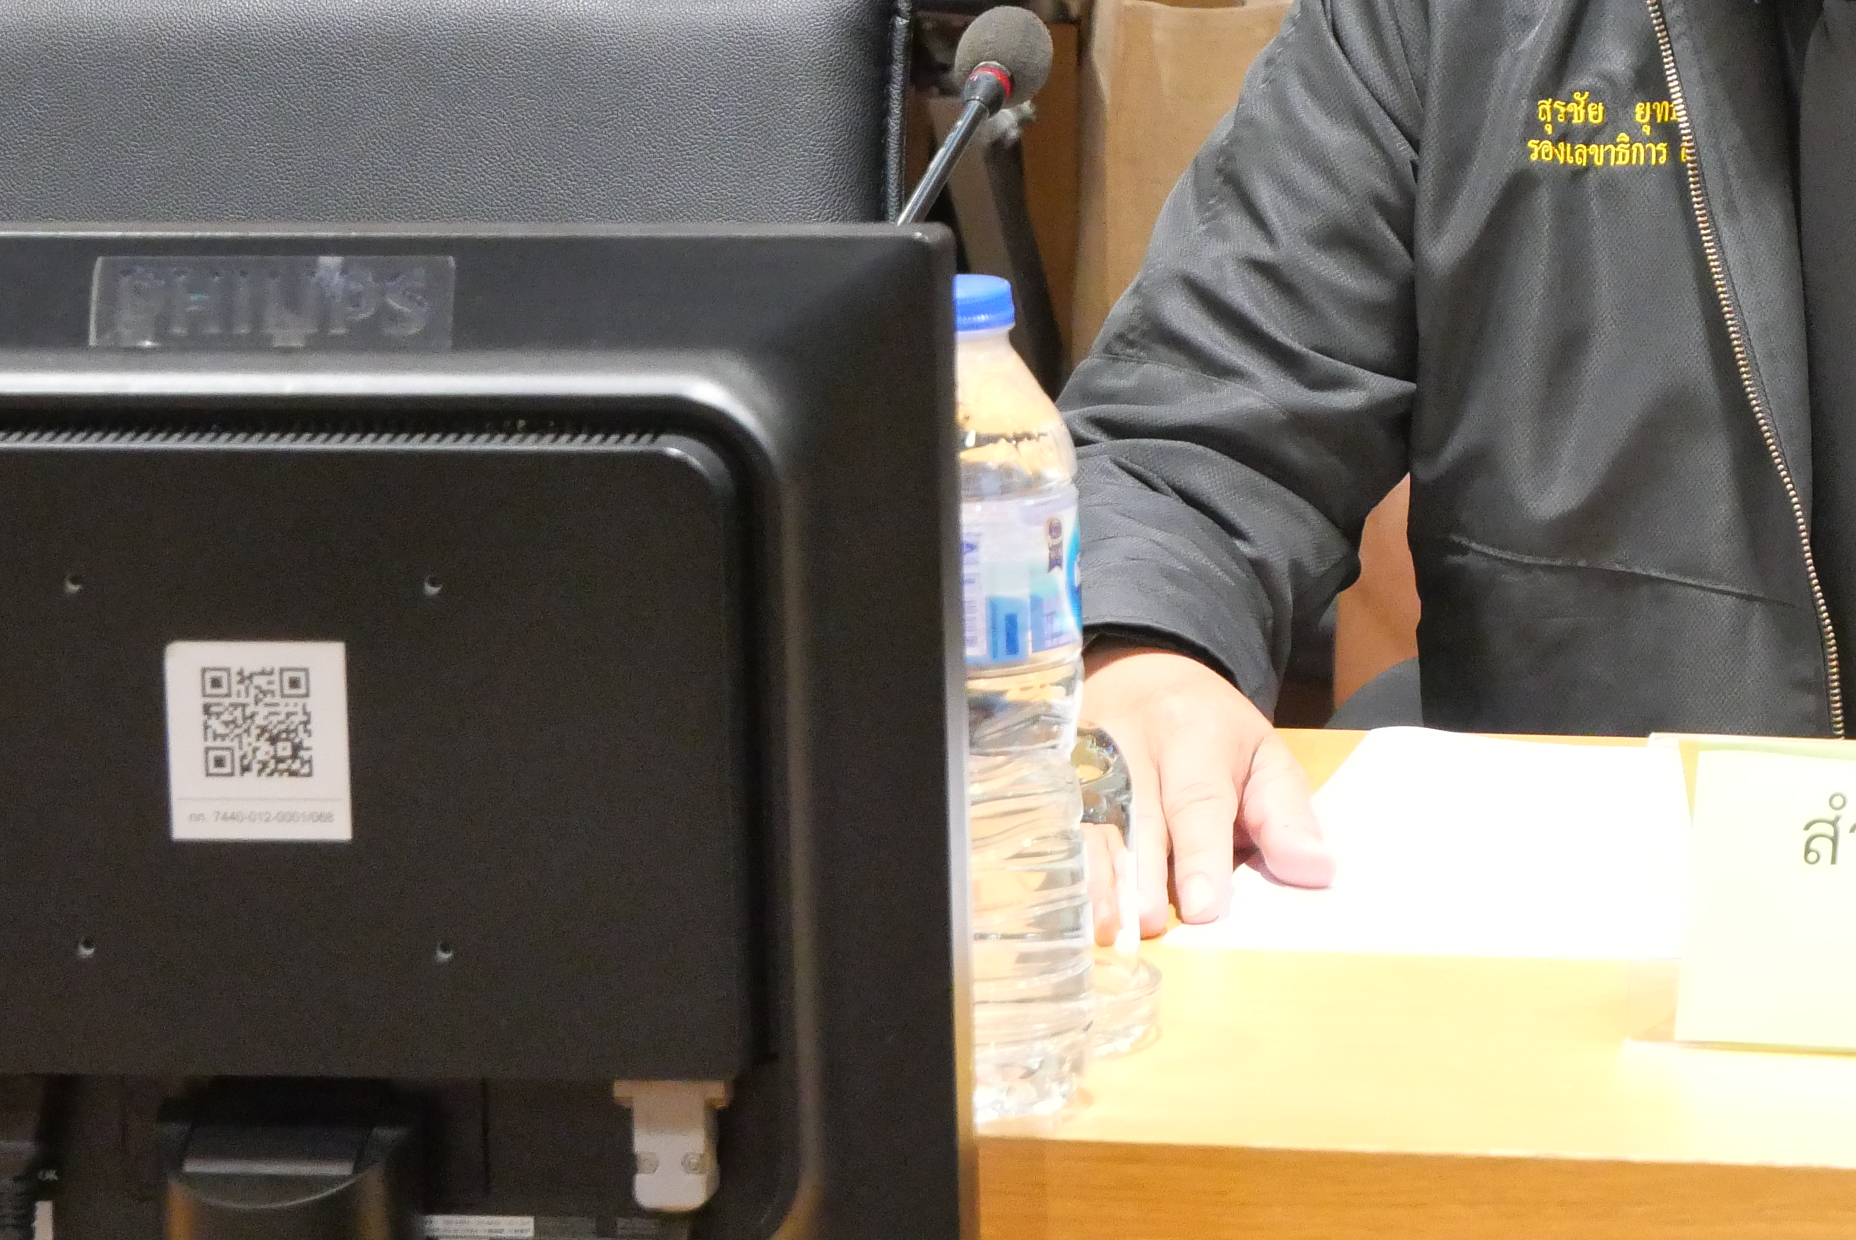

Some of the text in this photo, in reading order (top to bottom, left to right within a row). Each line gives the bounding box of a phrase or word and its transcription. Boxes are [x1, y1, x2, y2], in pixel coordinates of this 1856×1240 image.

[1537, 91, 1605, 135] สุรชัย
[1527, 132, 1668, 167] รองเลขาธิการ
